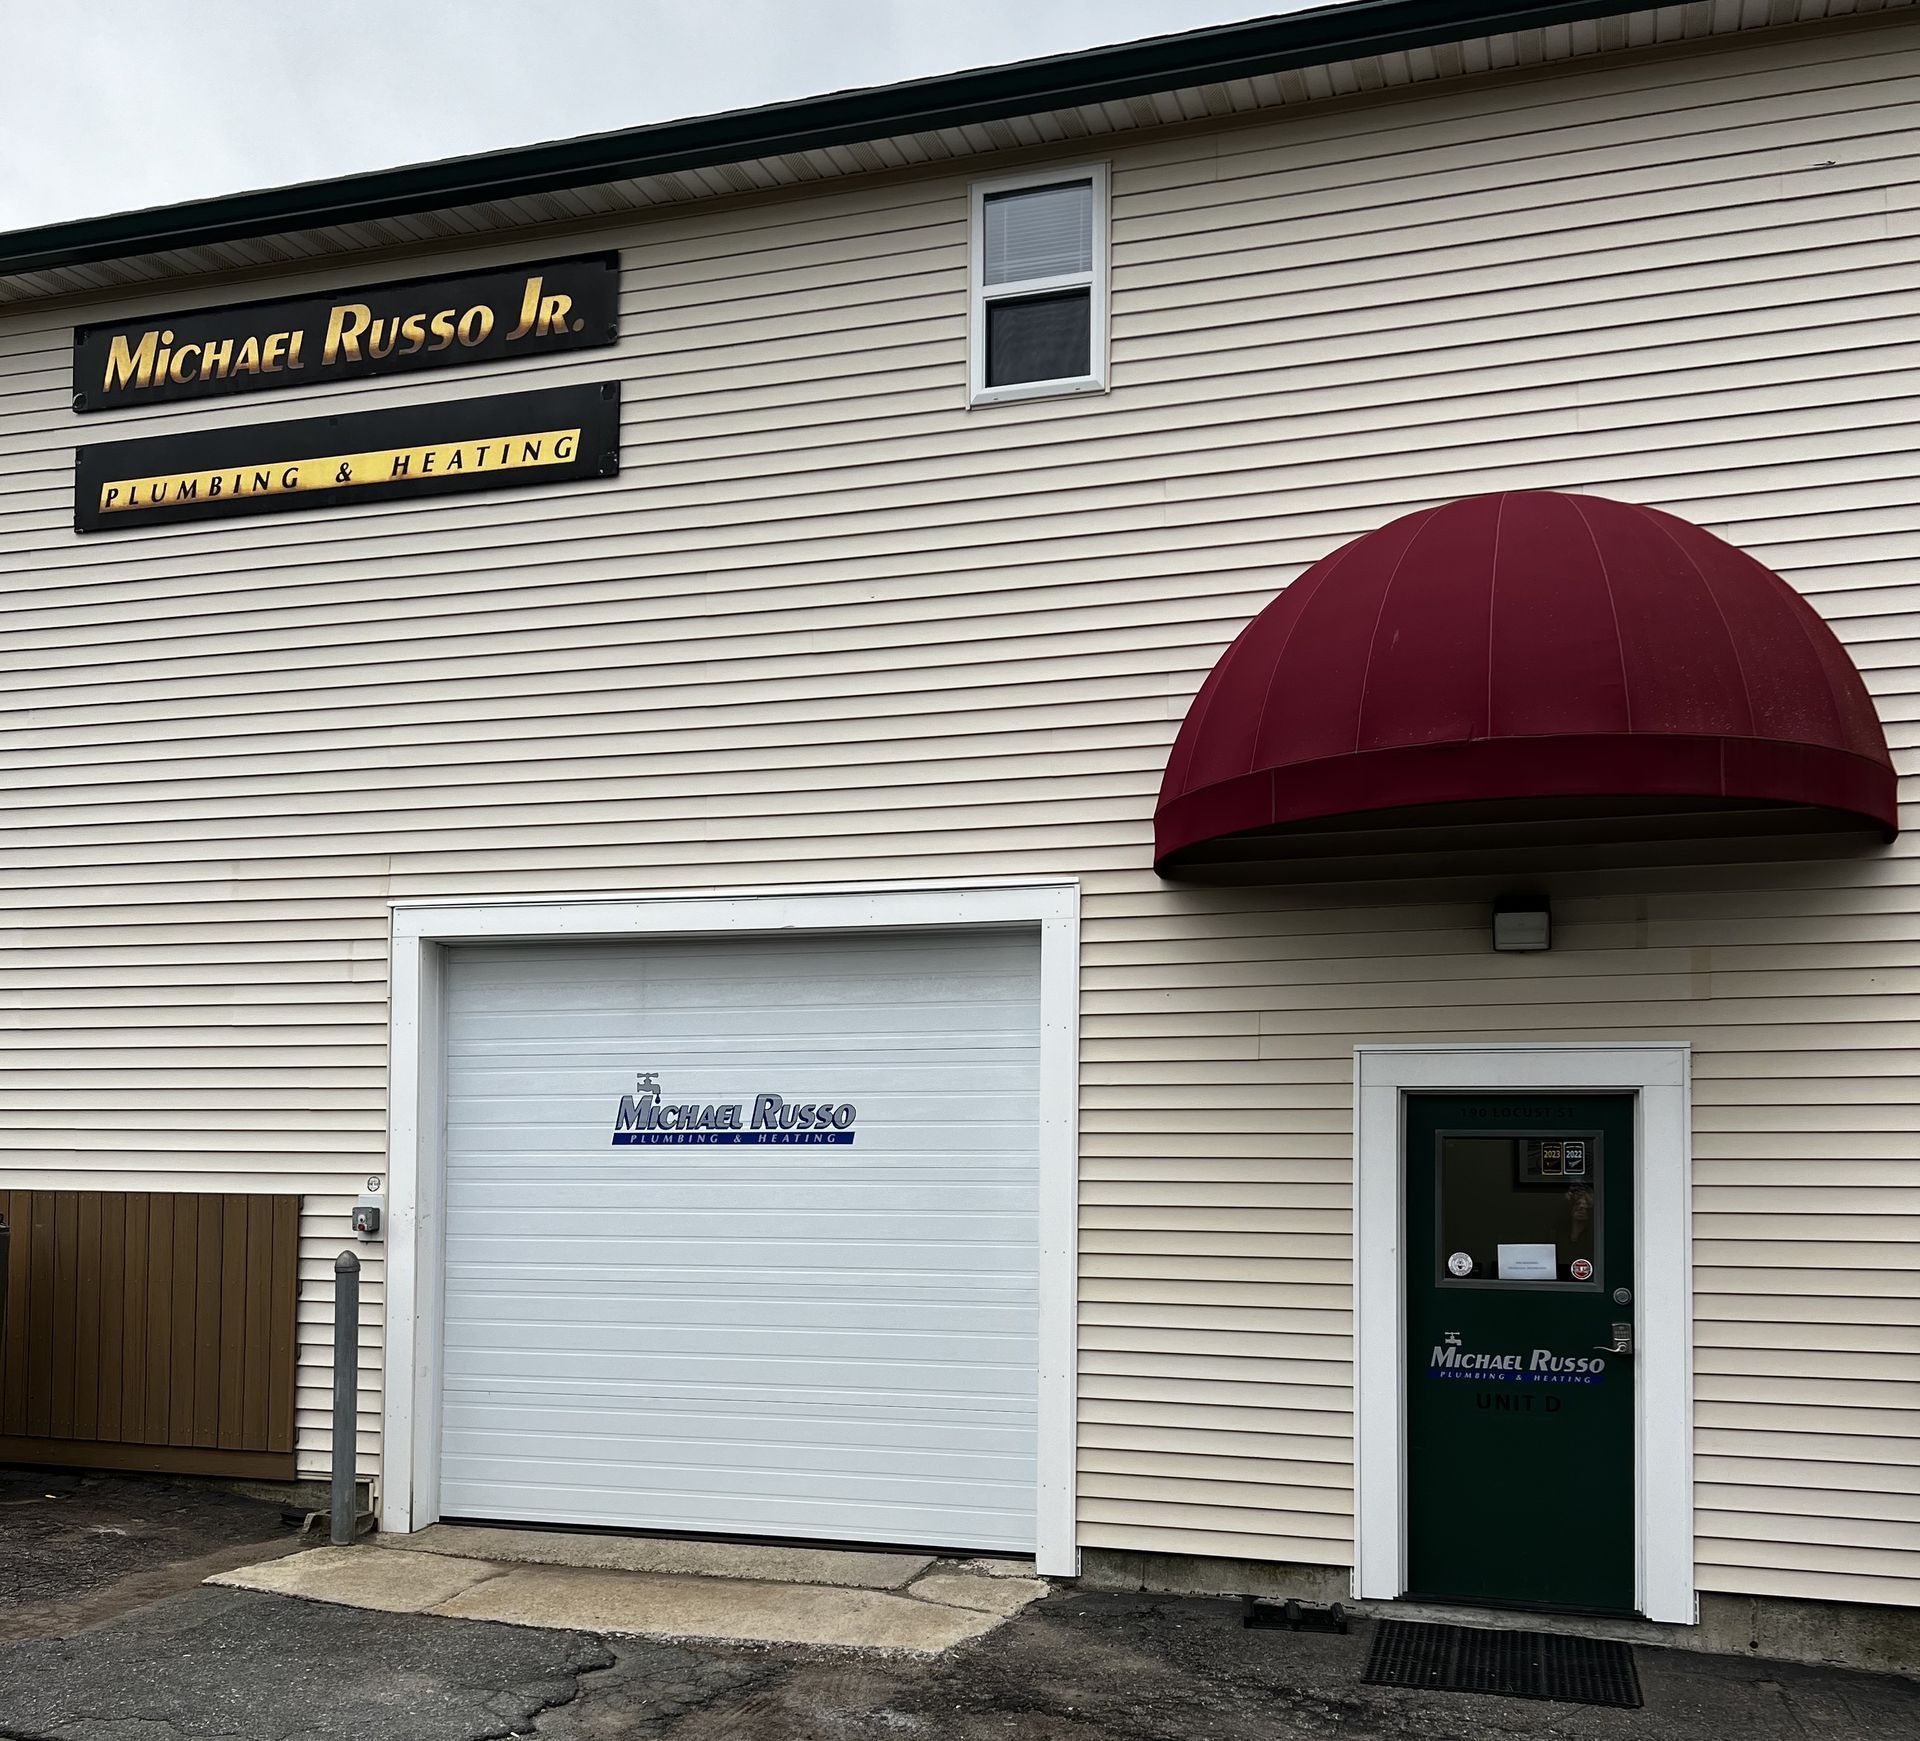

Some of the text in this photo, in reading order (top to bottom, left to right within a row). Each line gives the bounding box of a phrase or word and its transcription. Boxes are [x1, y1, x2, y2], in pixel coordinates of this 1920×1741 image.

[322, 303, 495, 366] RUSSO
[104, 436, 574, 508] PLUMBING & HEATING
[750, 1093, 857, 1130] RUSSO
[1493, 1107, 1552, 1119] LOCUST
[1557, 1107, 1577, 1119] ST
[630, 1133, 837, 1144] PLUMBING & HEATING
[1543, 1150, 1561, 1159] 2023
[1566, 1150, 1583, 1159] 2022
[1529, 1349, 1606, 1373] RUSSO
[1440, 1371, 1505, 1381] PLUMBING
[1533, 1374, 1592, 1384] HEATING
[1476, 1393, 1562, 1413] UNIT D
